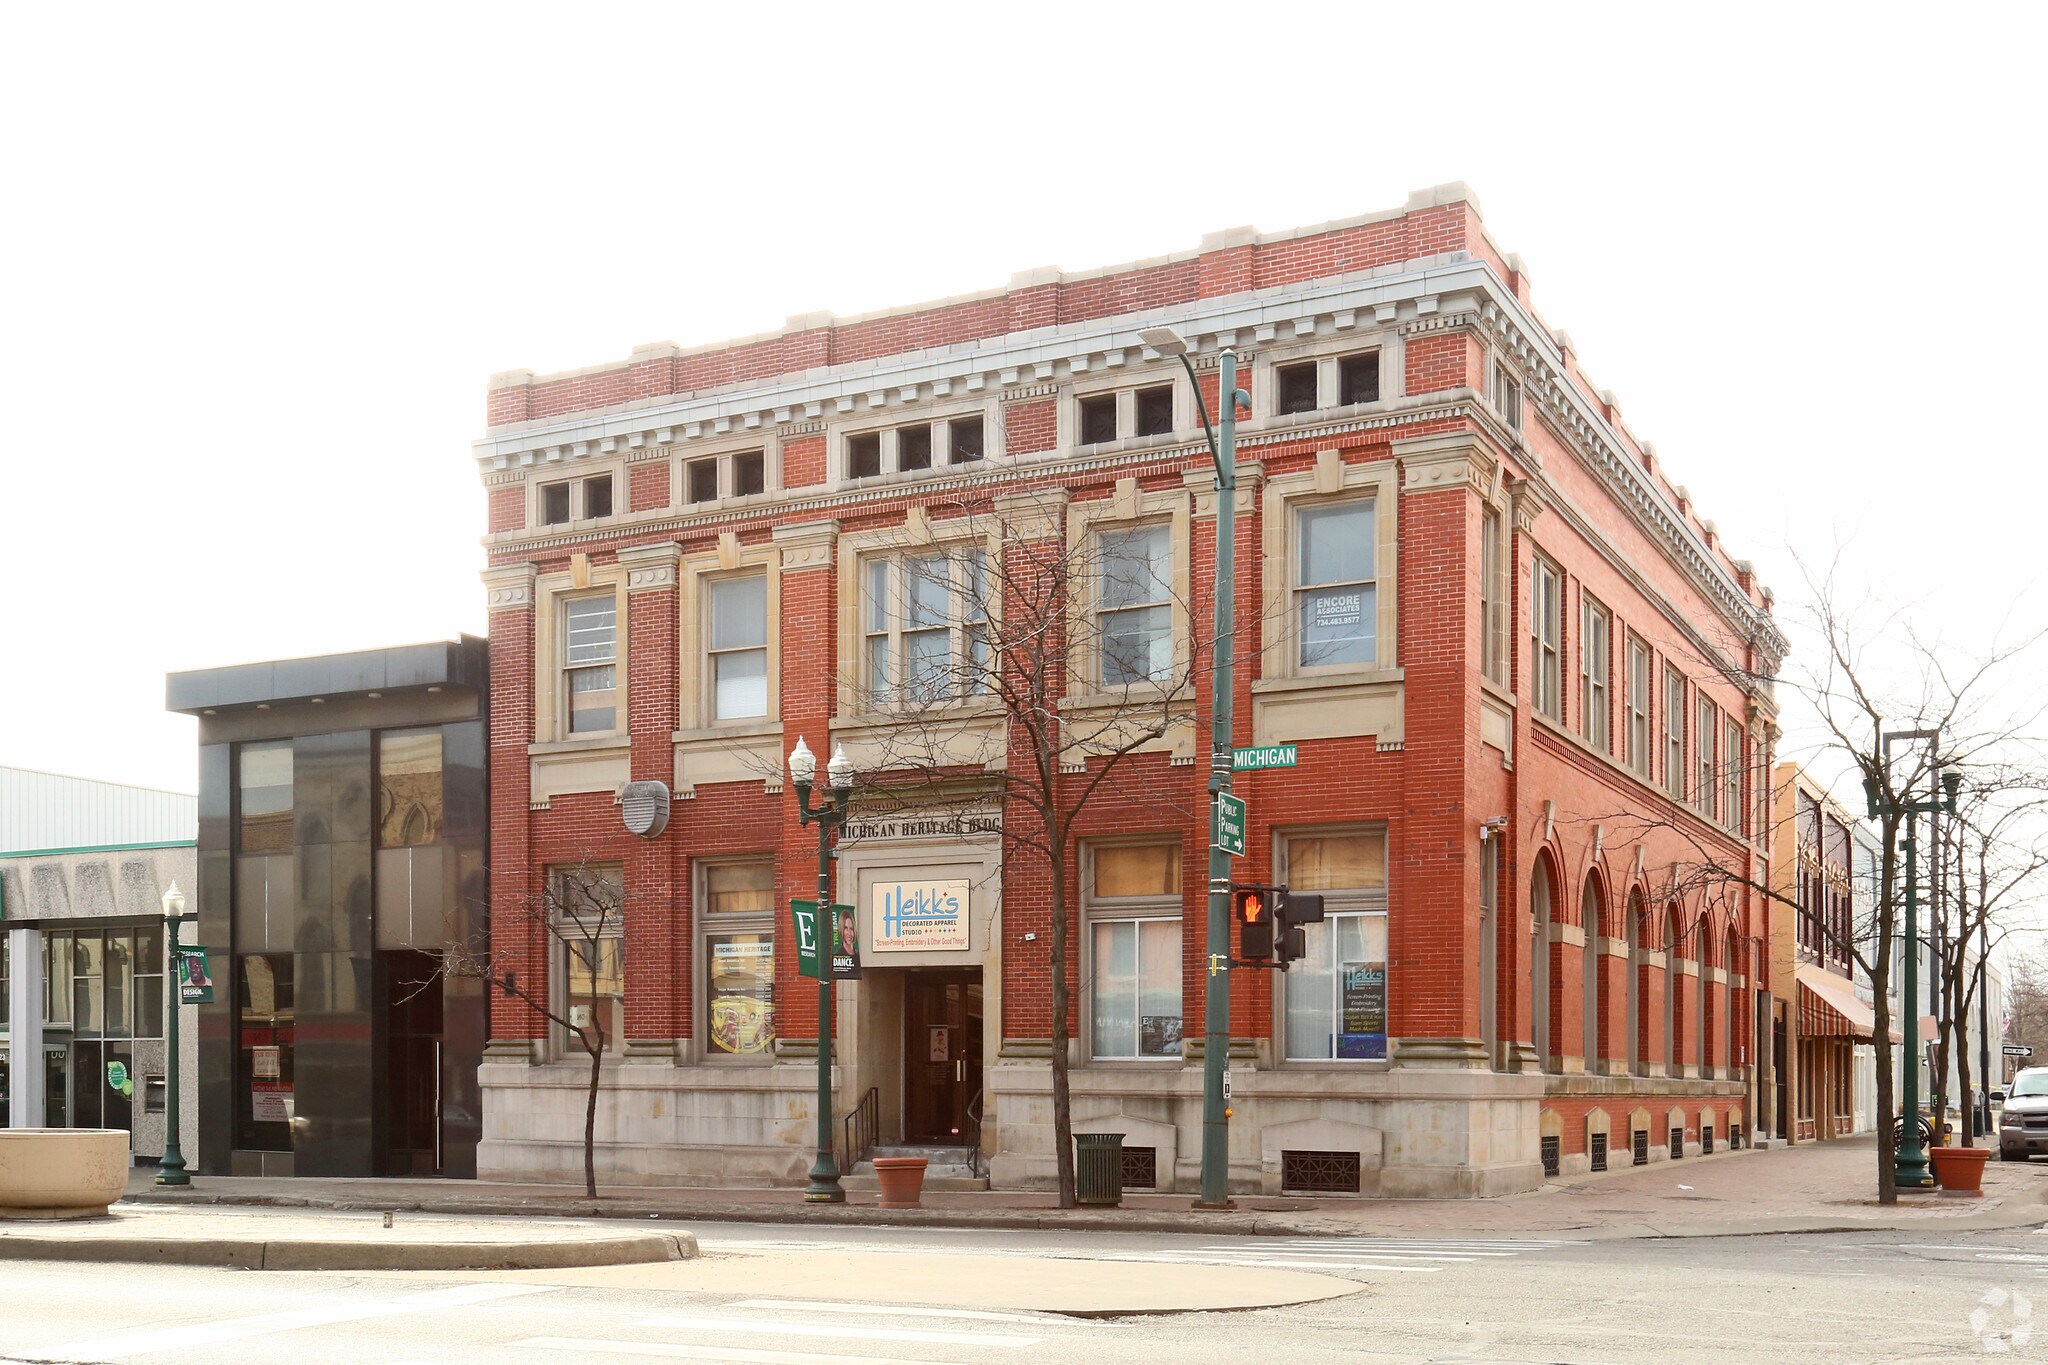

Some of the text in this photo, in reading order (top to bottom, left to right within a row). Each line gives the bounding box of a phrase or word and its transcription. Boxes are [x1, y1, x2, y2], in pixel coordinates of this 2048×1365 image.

[1316, 595, 1360, 608] ENCORE
[1316, 605, 1360, 615] ASSOCIATES
[1316, 617, 1360, 627] 734.483.9577
[1234, 748, 1296, 768] MICHIGAN
[1221, 798, 1237, 817] PUBLIC
[838, 823, 896, 839] MICHIGAN
[901, 820, 963, 836] HERITAGE
[1221, 817, 1240, 837] PARKING
[1221, 834, 1230, 847] LOT
[796, 911, 816, 951] E
[743, 945, 771, 953] HERITAGE
[905, 938, 926, 947] Embroidery
[833, 957, 855, 967] DANCE.
[183, 988, 204, 996] DESIGN.
